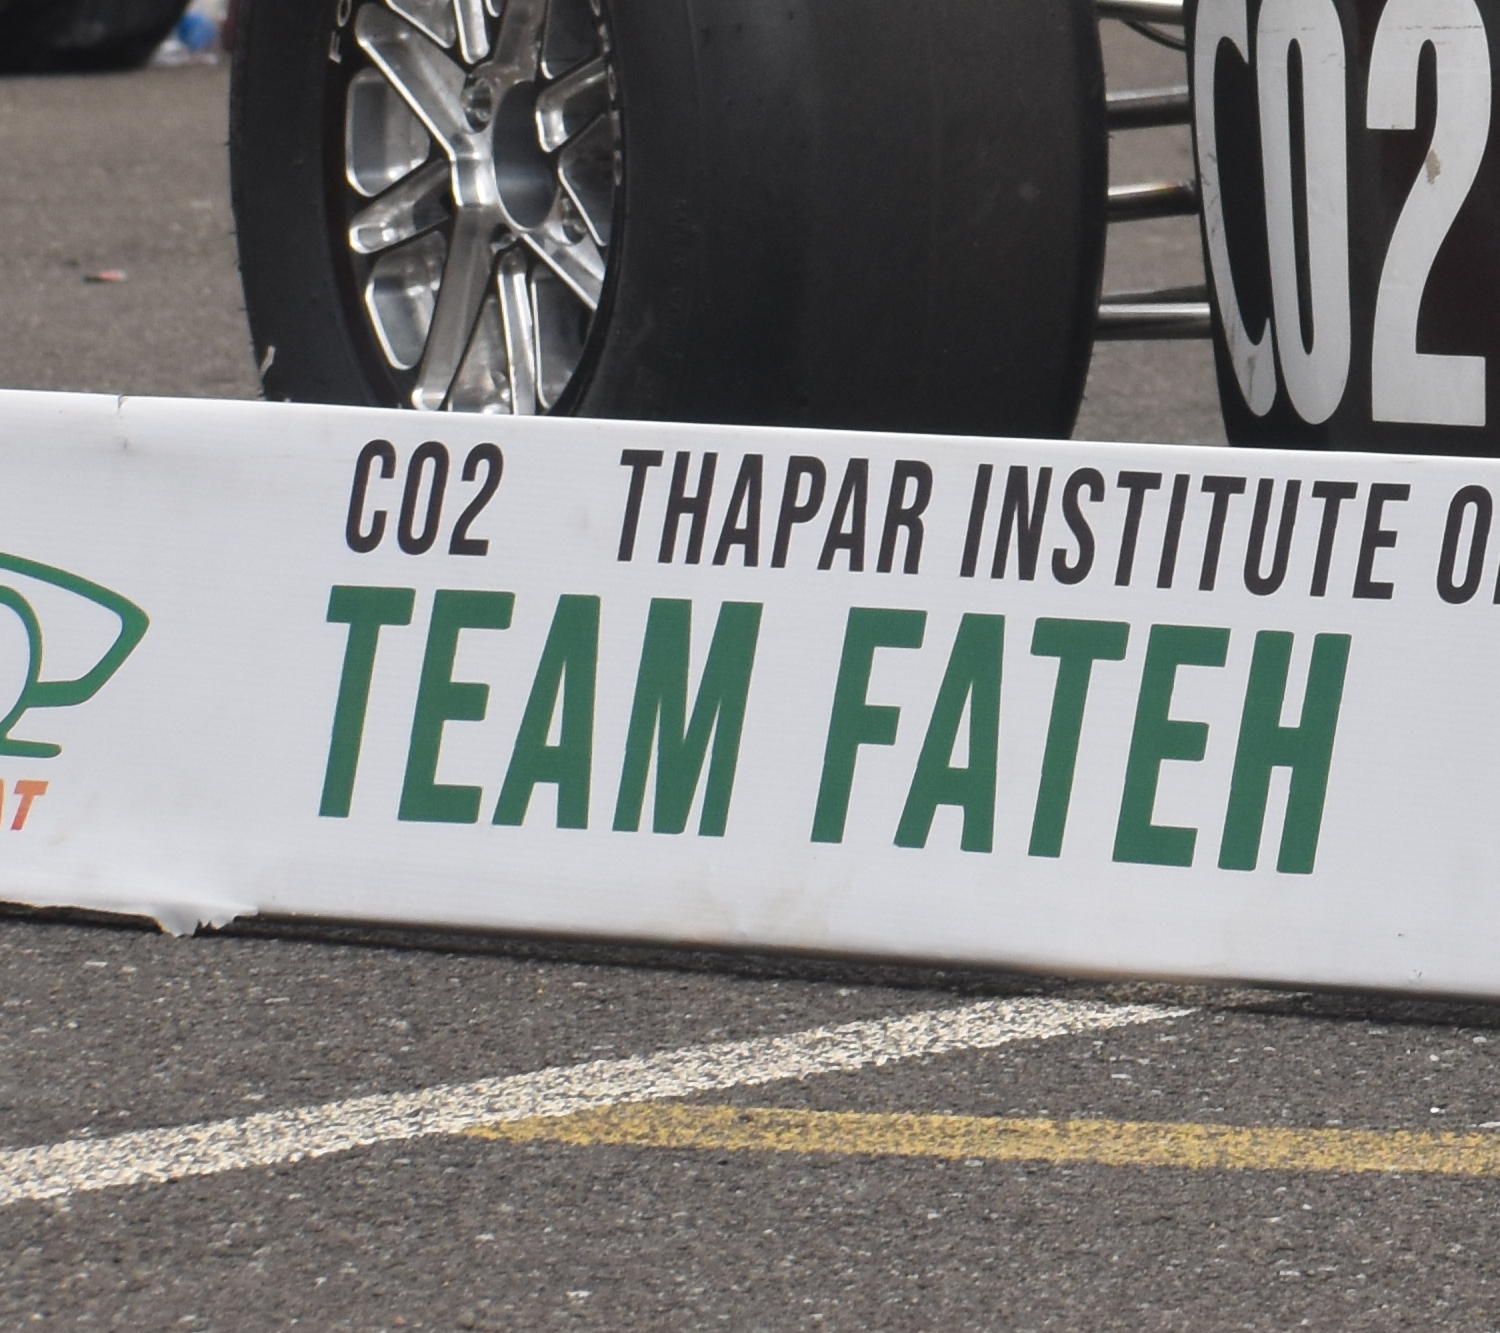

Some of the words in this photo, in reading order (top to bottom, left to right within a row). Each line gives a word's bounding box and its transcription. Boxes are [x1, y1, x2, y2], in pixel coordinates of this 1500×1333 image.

[617, 448, 934, 576] THAPAR
[960, 461, 1412, 603] INSTITUTE
[318, 584, 764, 839] TEAM
[809, 606, 1353, 876] FATEH
